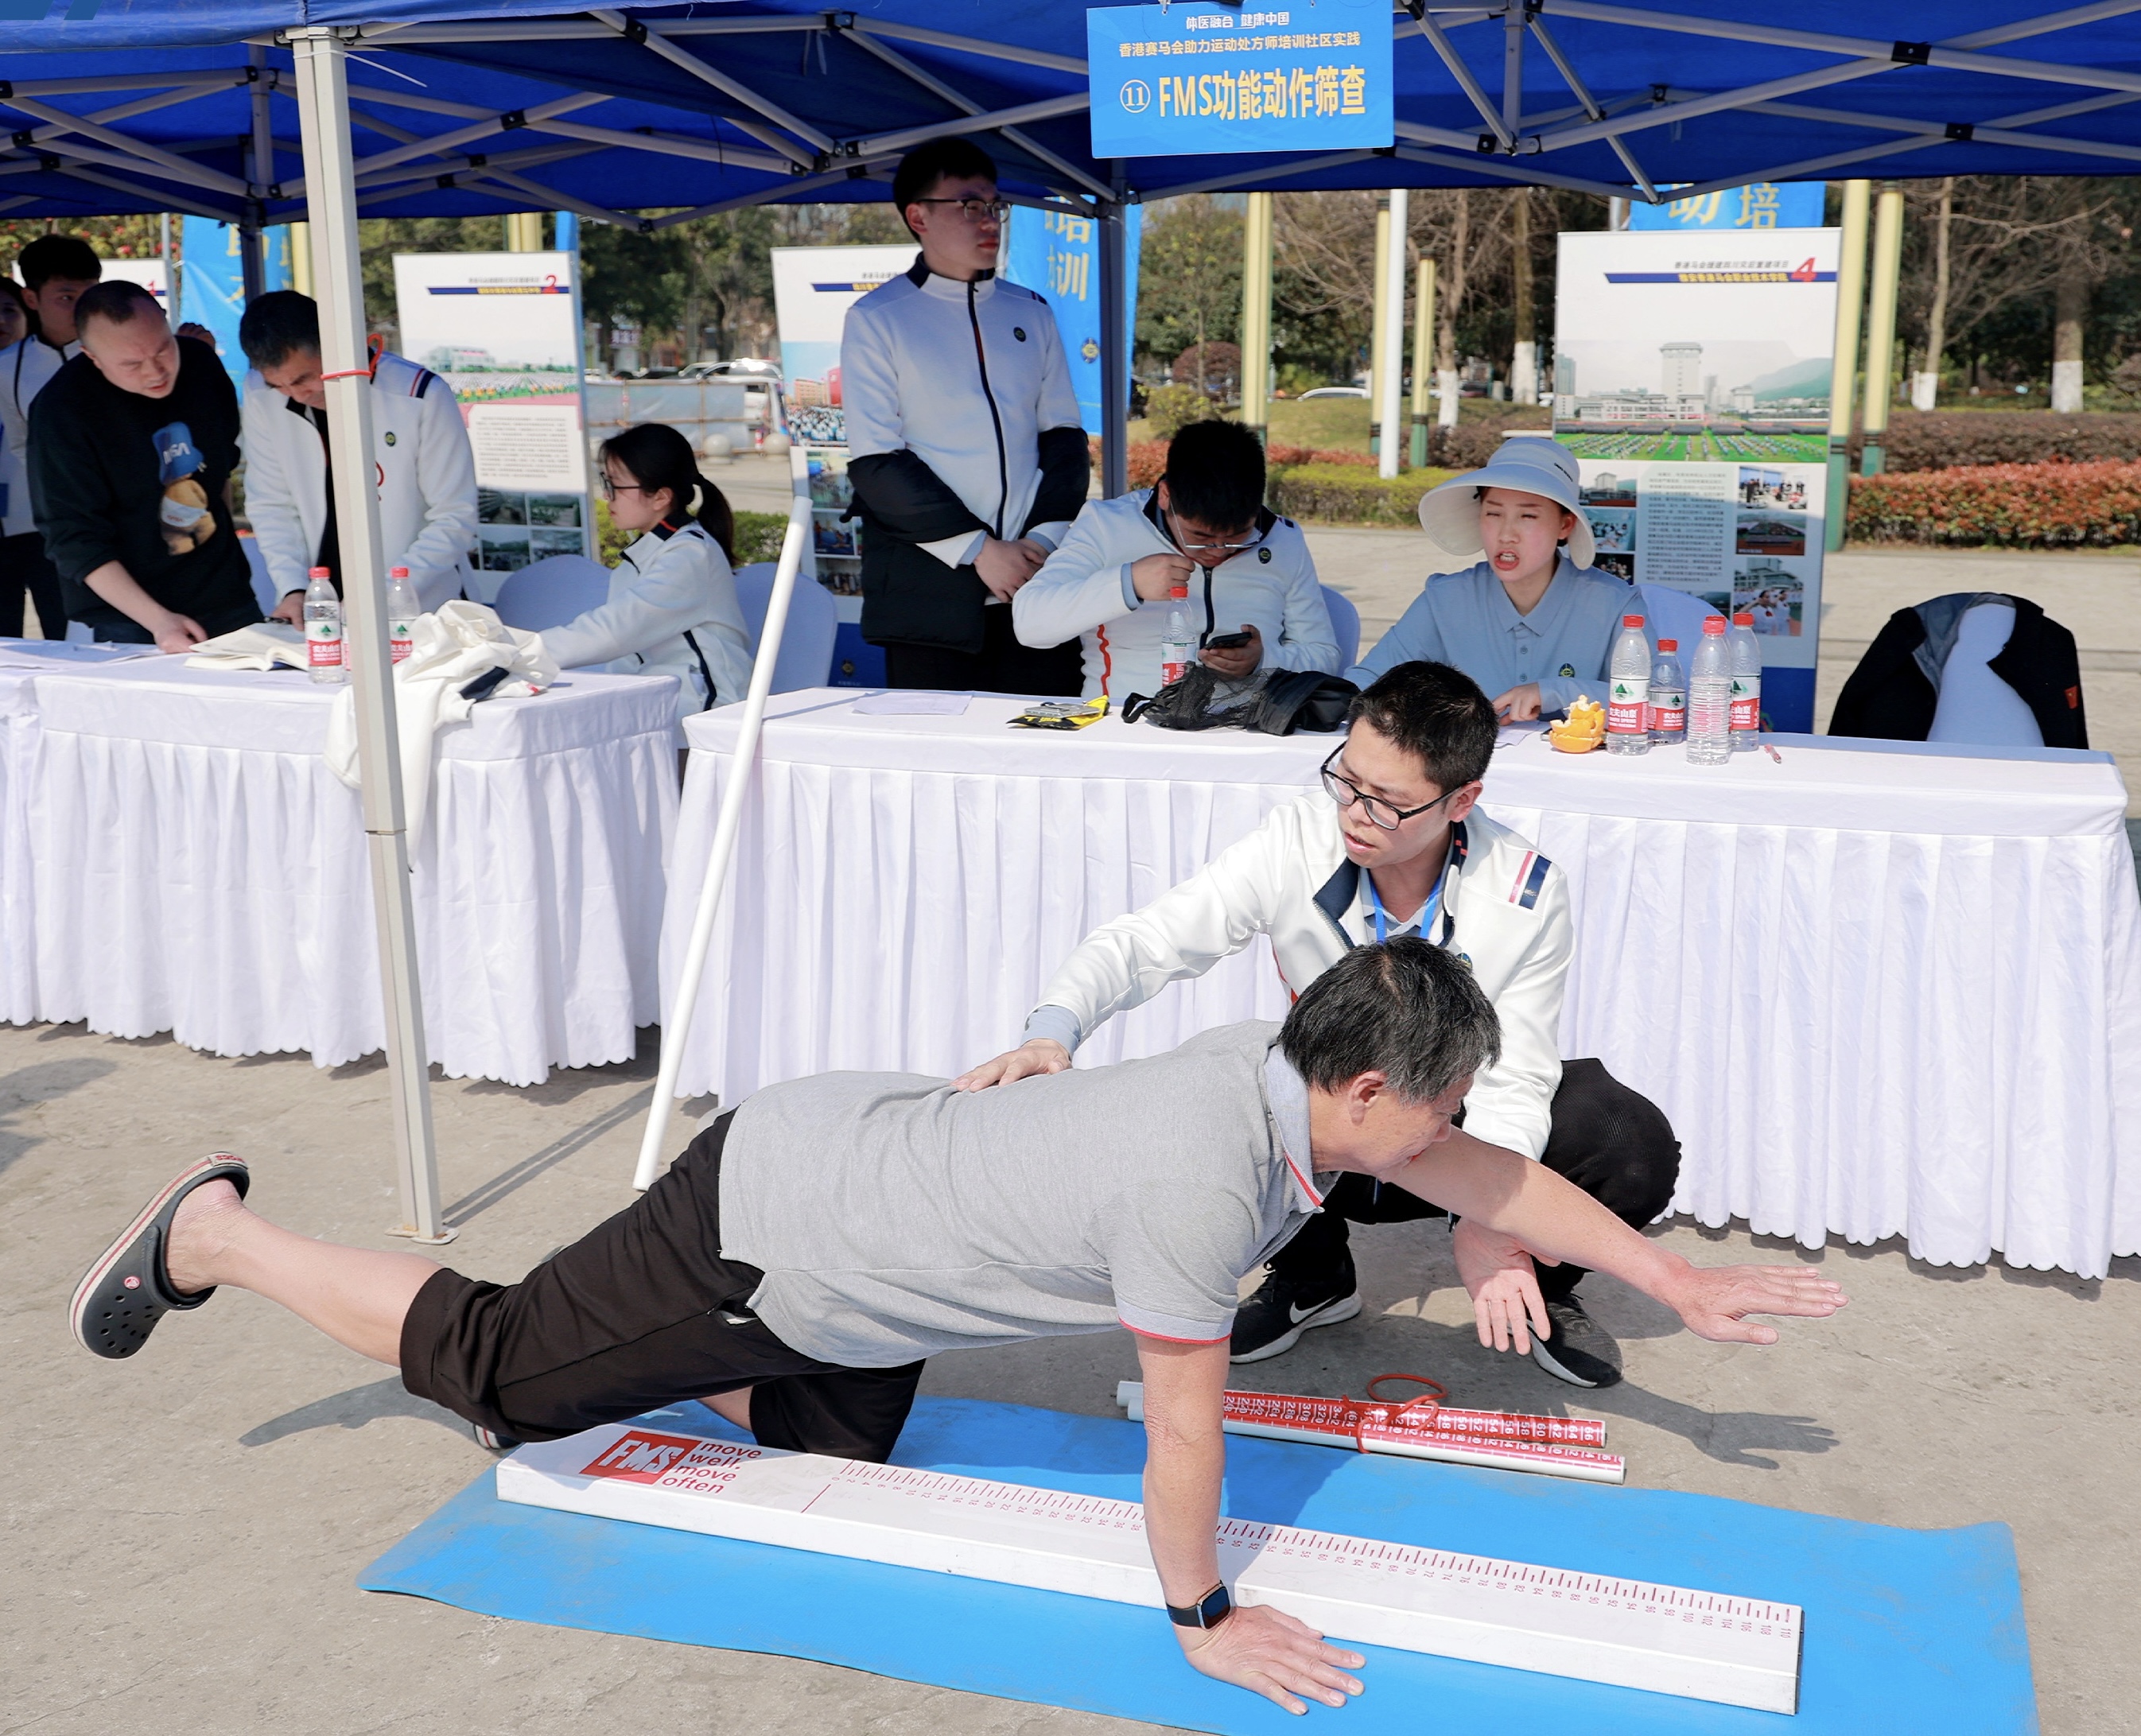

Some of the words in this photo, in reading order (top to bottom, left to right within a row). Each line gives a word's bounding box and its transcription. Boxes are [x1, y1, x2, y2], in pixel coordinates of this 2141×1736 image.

[1186, 15, 1234, 32] 体医融合
[1241, 11, 1289, 29] 健康中国
[1119, 32, 1361, 57] 香港赛马会助力运动处方师培训社区实践
[1159, 64, 1366, 120] FMS功能动作筛查
[1791, 257, 1817, 283] 4
[542, 275, 560, 294] 2
[1441, 1416, 1451, 1429] 48
[1457, 1416, 1467, 1431] 50
[1473, 1418, 1484, 1431] 52
[1489, 1419, 1499, 1433] 54
[1504, 1420, 1514, 1435] 56
[1521, 1422, 1531, 1436] 58
[1537, 1423, 1547, 1437] 60
[1552, 1424, 1563, 1439] 62
[1568, 1426, 1579, 1440] 64
[1583, 1427, 1595, 1441] 66
[597, 1439, 685, 1474] FMS
[690, 1454, 740, 1470] well.
[700, 1443, 762, 1459] move
[662, 1477, 724, 1494] often
[674, 1466, 736, 1482] move
[1370, 1561, 1381, 1570] 66
[1683, 1613, 1694, 1622] 100
[1702, 1616, 1713, 1625] 102
[1722, 1619, 1733, 1629] 104
[1741, 1622, 1753, 1632] 106
[1760, 1625, 1772, 1635] 108
[1780, 1628, 1792, 1639] 110
